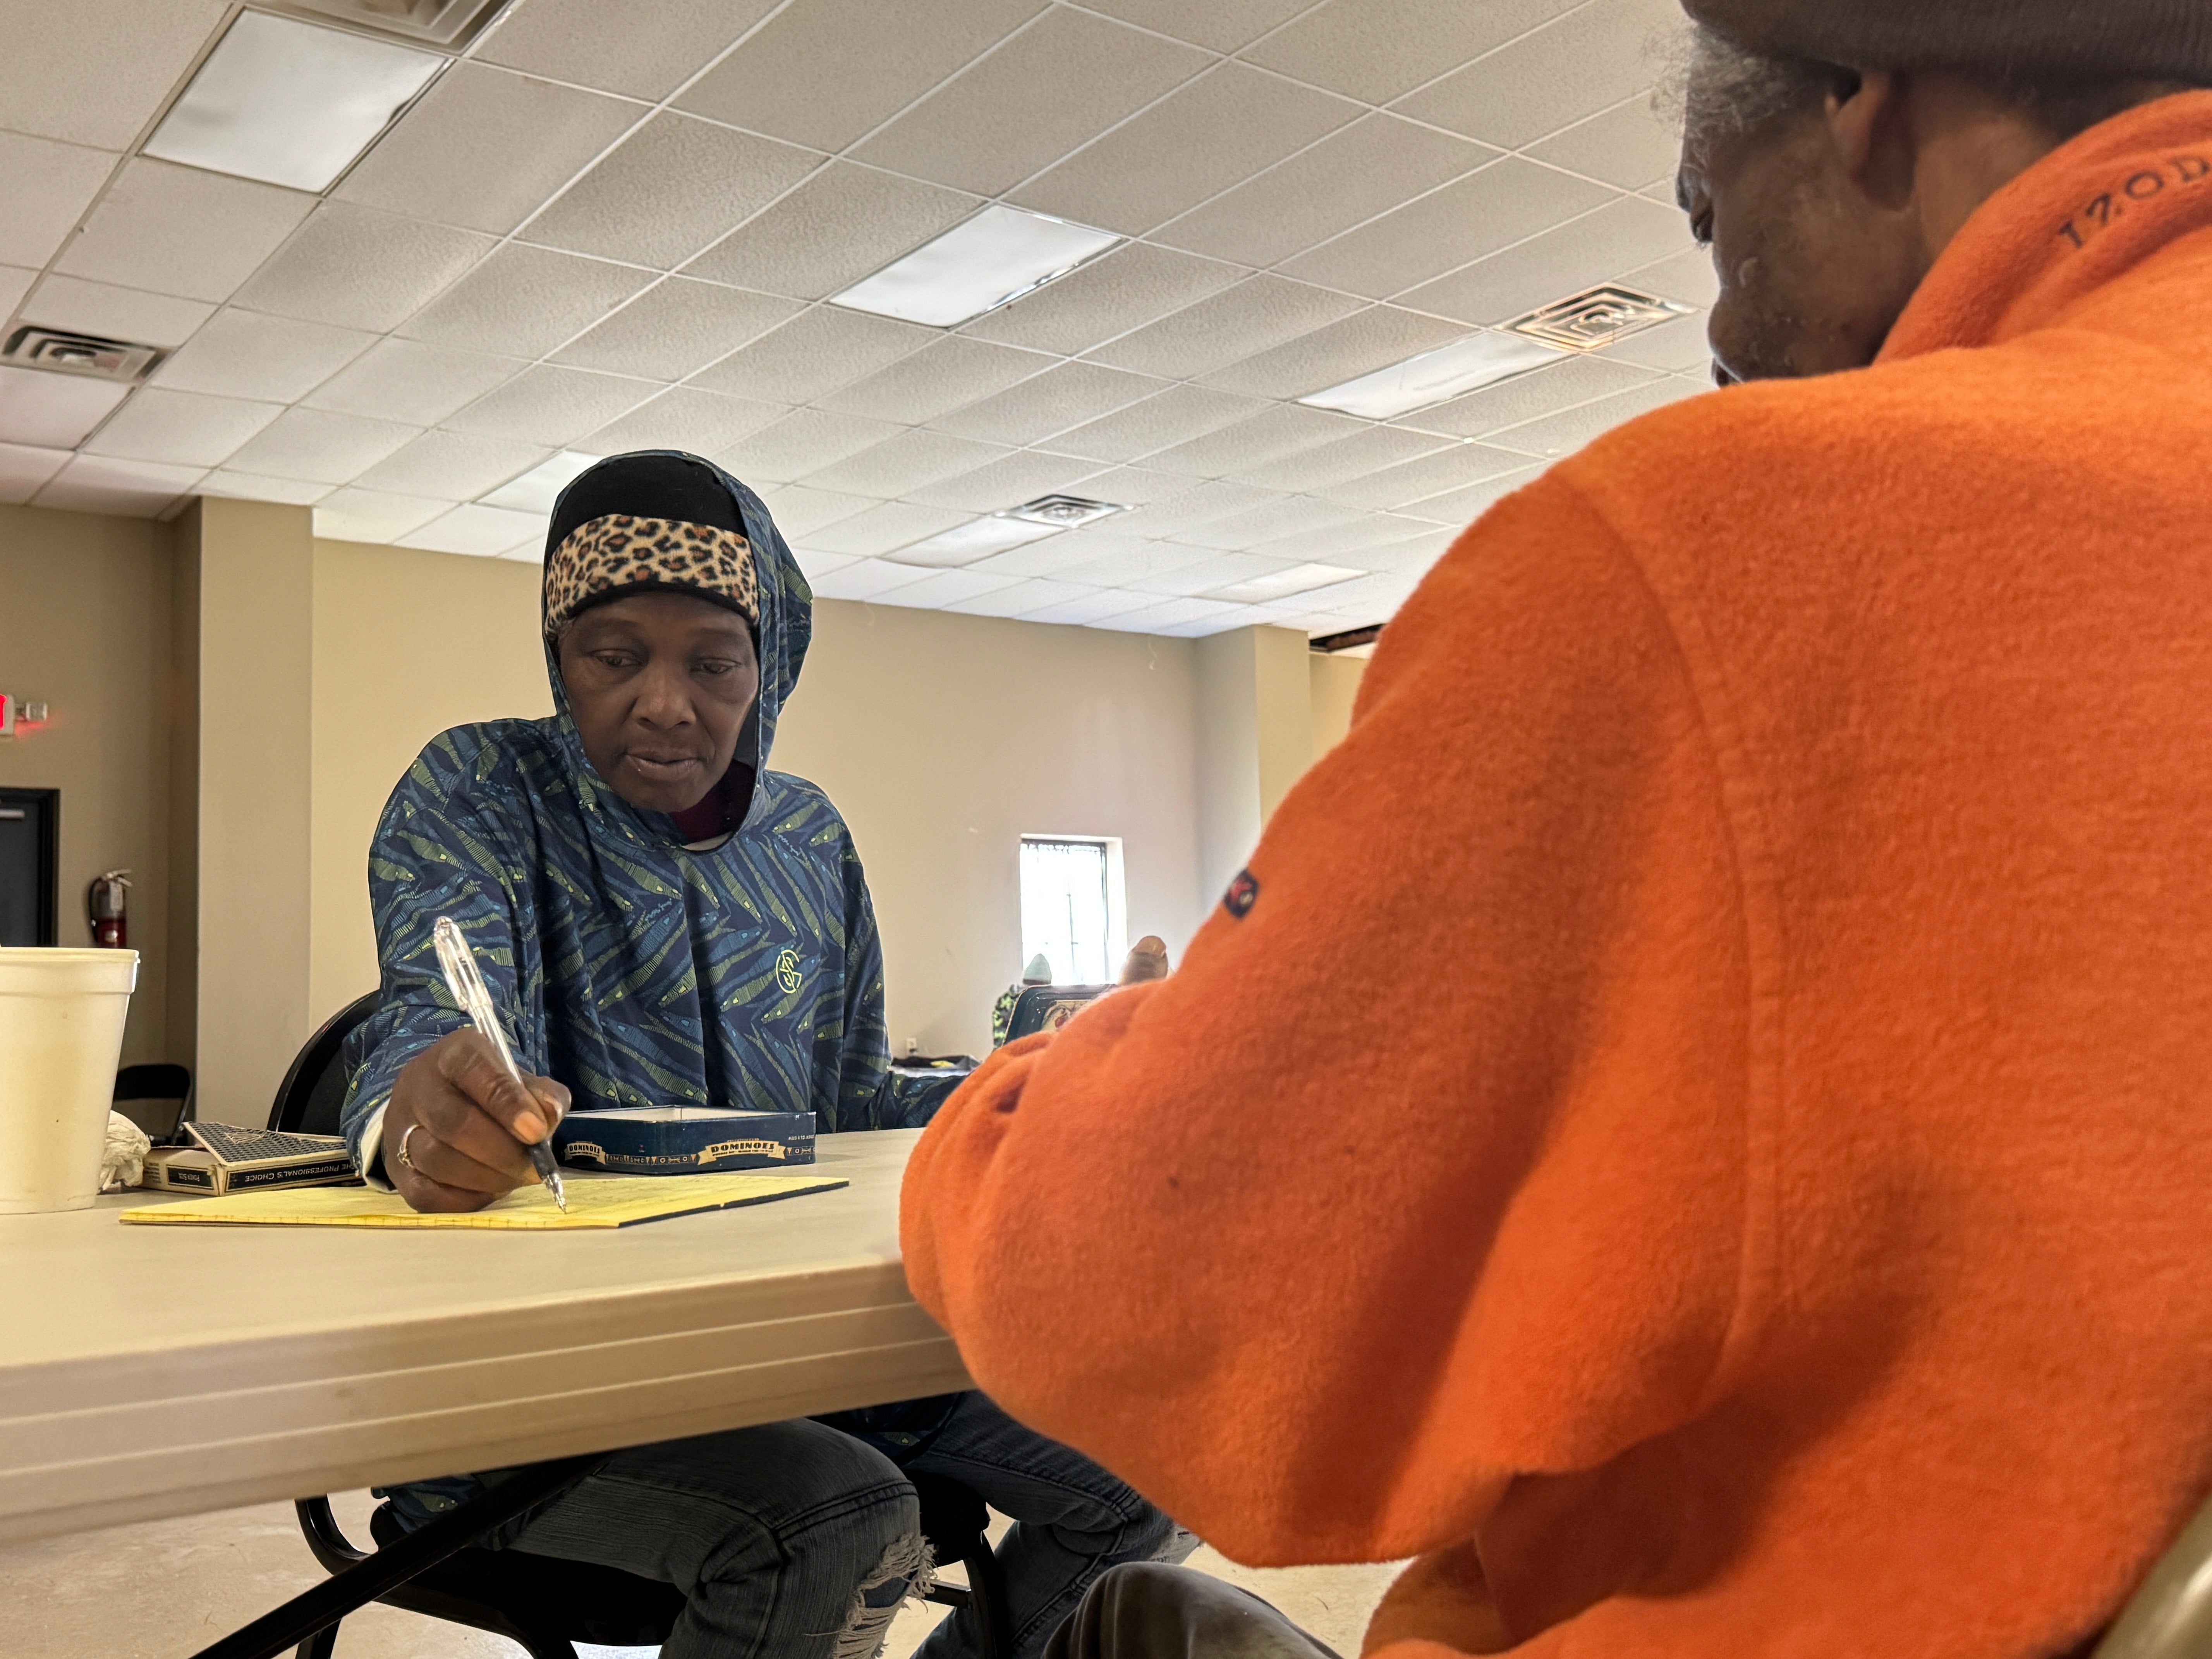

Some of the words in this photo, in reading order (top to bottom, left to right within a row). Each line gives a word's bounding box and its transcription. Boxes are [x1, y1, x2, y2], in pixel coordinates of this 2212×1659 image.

[569, 1145, 600, 1154] DOMINOES
[711, 1142, 775, 1153] DOMINOES
[276, 1164, 339, 1178] PROFESSIONAL'S
[244, 1173, 275, 1182] CHOICE
